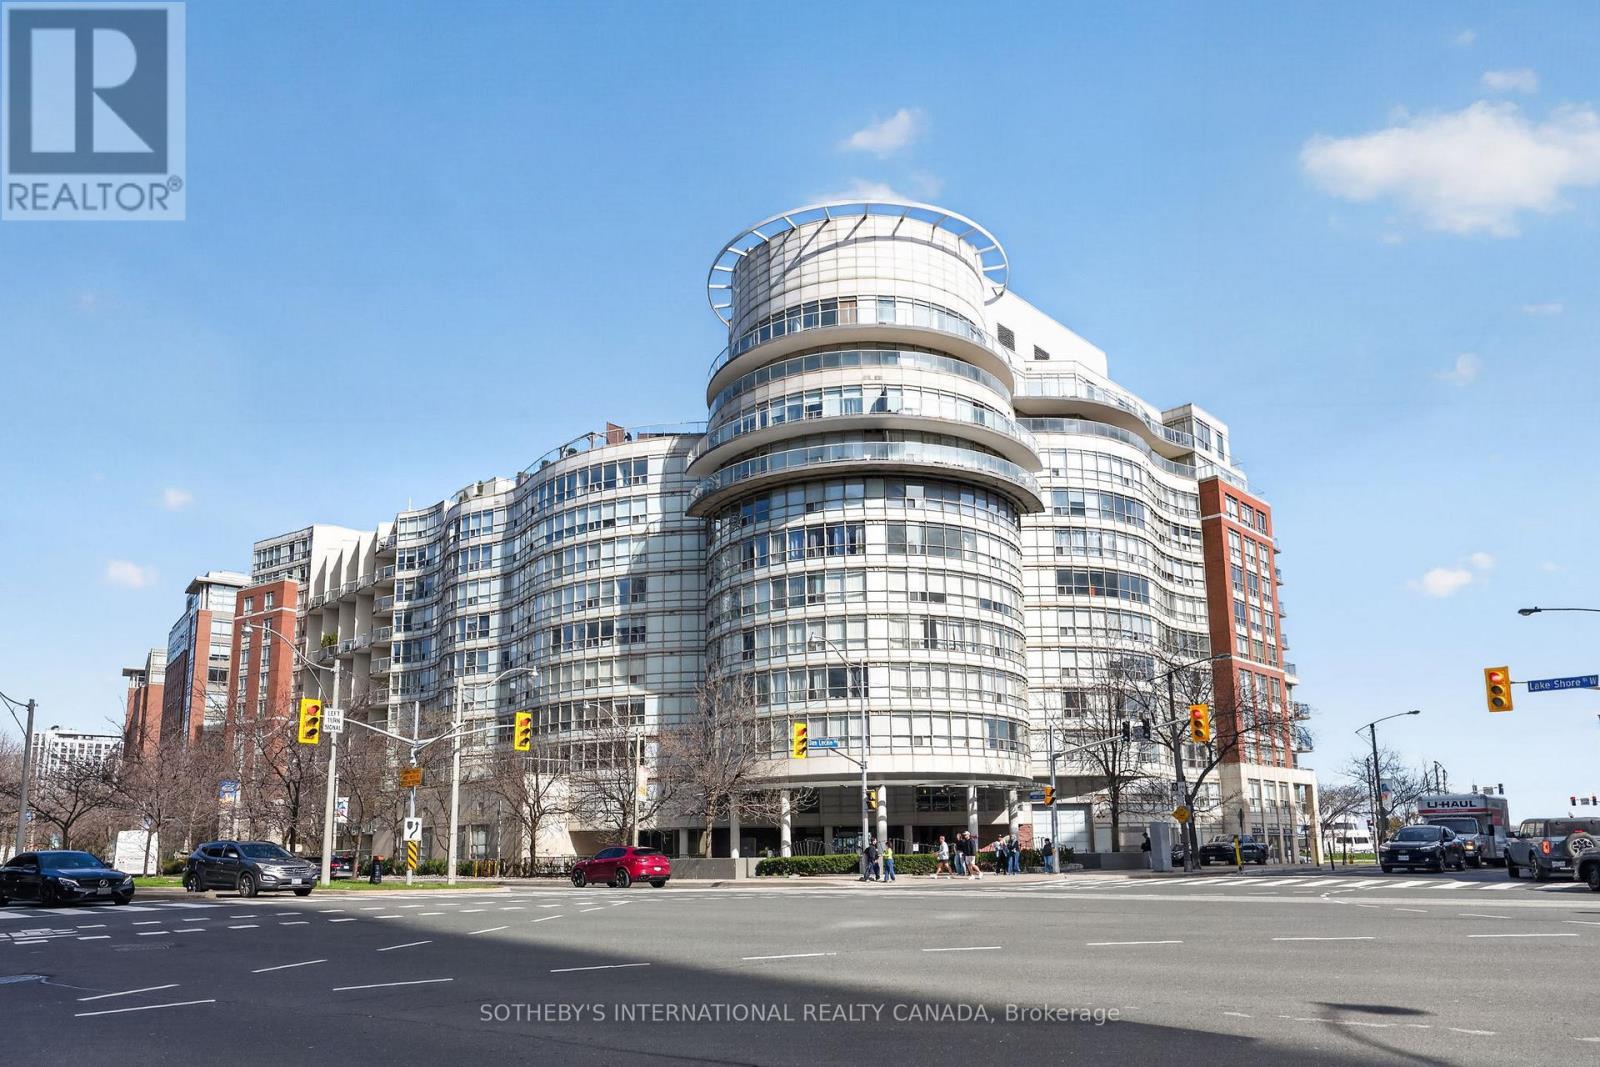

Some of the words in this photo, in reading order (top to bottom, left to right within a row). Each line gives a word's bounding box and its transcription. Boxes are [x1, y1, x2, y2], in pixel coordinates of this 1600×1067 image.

[1529, 681, 1551, 691] Lake
[1553, 679, 1581, 689] Shore
[1427, 800, 1477, 808] U-HAUL
